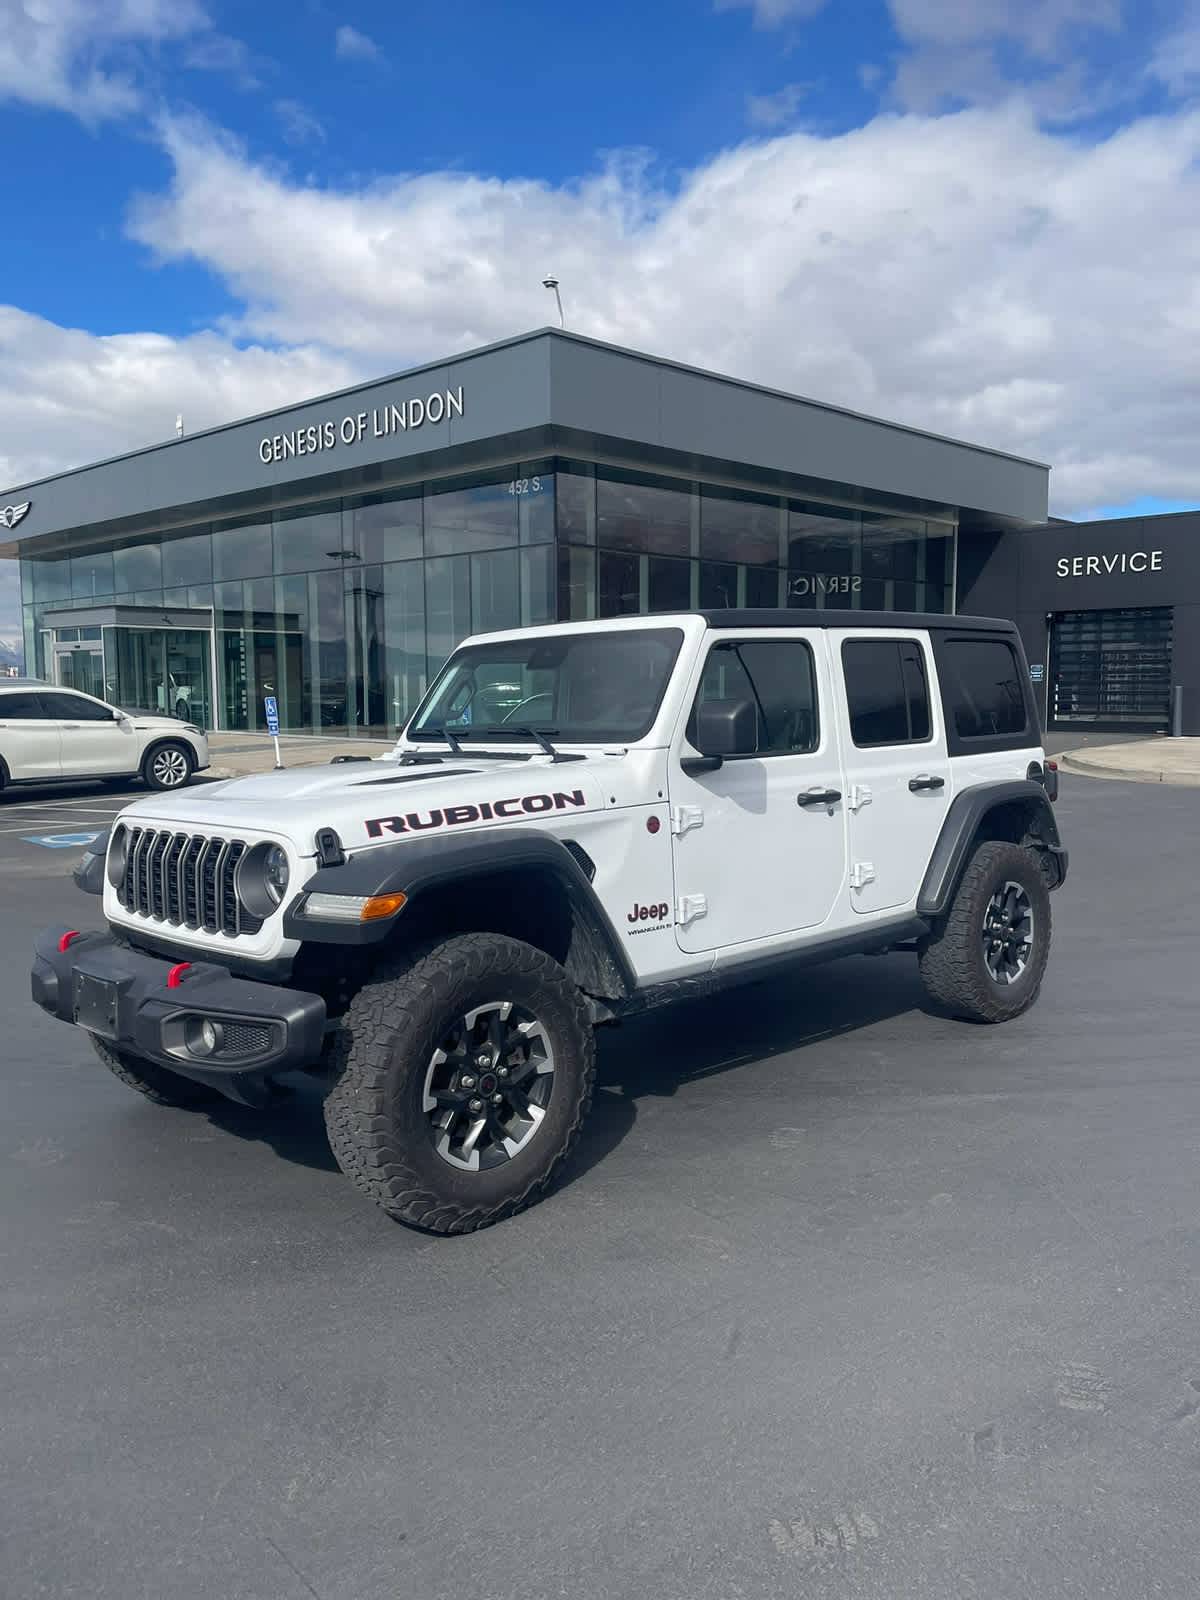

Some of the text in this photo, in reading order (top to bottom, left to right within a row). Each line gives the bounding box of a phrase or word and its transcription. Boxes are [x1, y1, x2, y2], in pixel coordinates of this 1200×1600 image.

[259, 386, 464, 464] GENESIS OF LINDON
[509, 479, 528, 495] 452
[1056, 550, 1163, 578] SERVICE
[365, 790, 586, 837] RUBICON
[627, 902, 669, 923] Jeep
